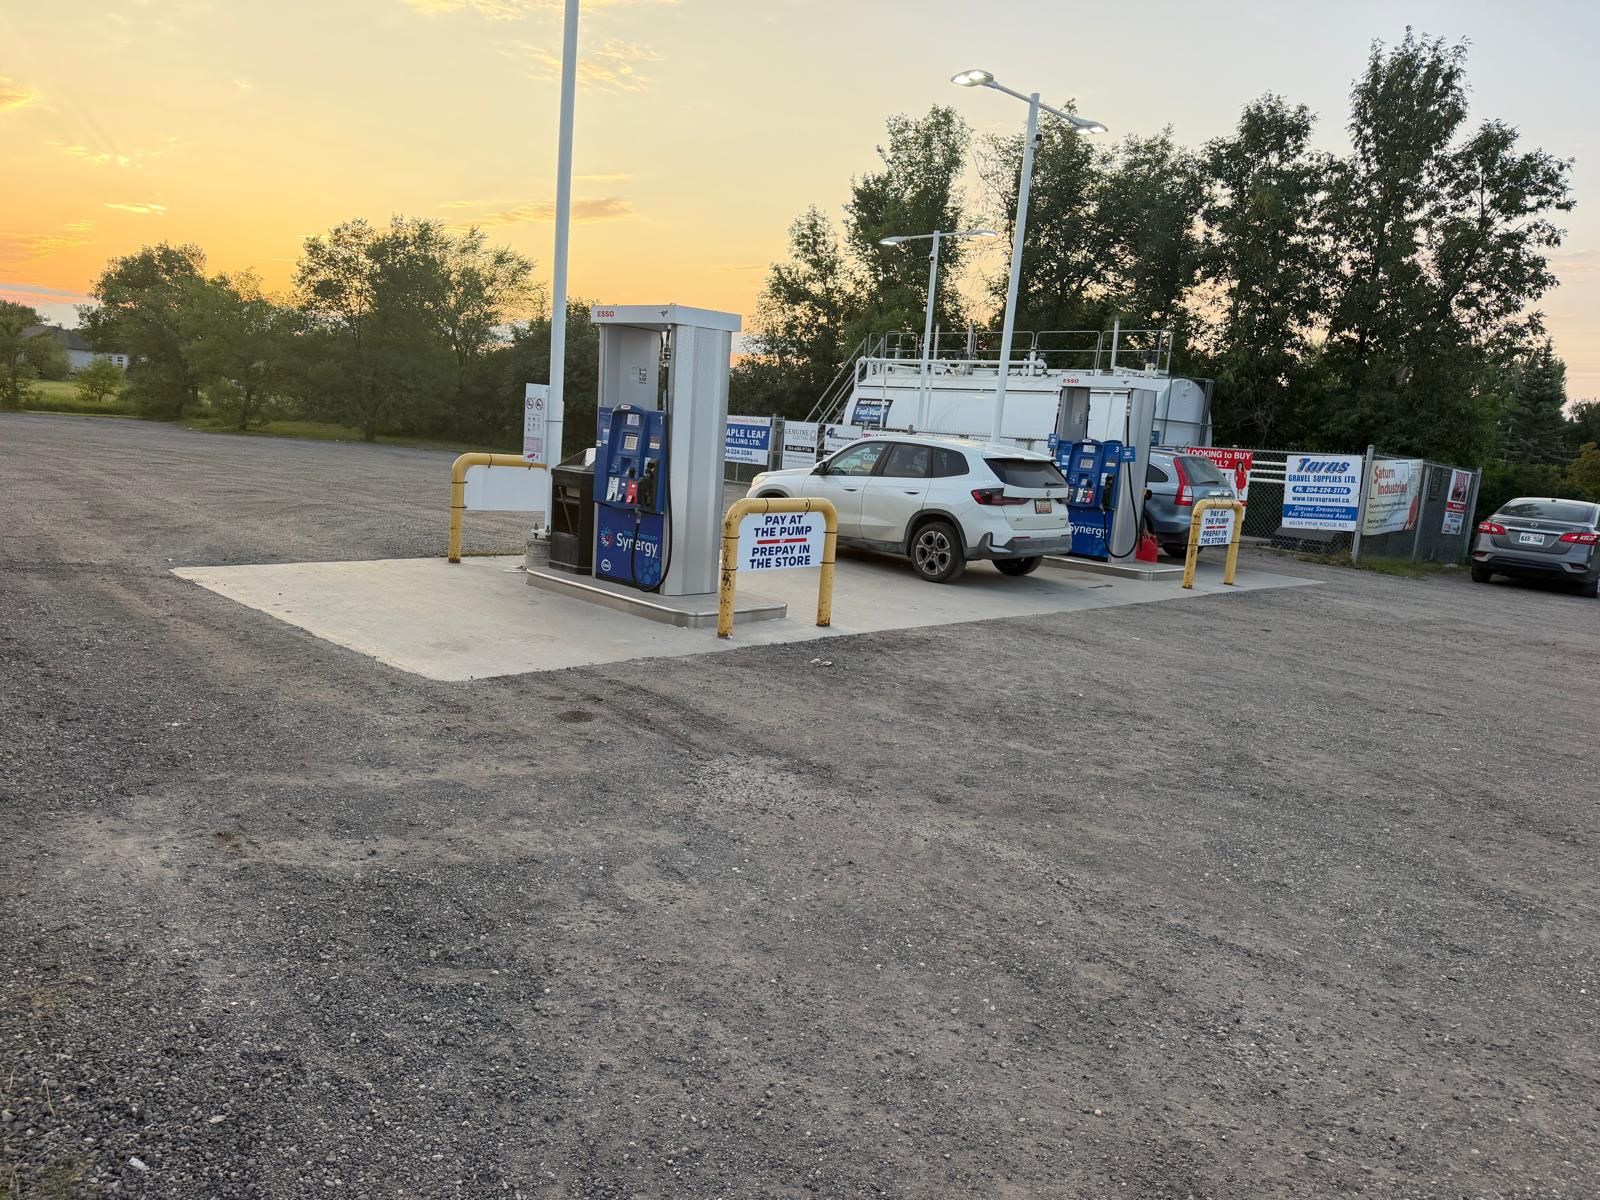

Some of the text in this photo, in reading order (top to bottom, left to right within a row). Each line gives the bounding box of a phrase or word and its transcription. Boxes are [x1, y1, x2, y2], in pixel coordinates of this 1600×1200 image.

[747, 430, 766, 439] LEAF
[1188, 449, 1252, 460] LOOKING to BUY
[1297, 457, 1350, 474] Taras
[1288, 474, 1310, 482] GRAVEL
[1313, 475, 1342, 483] SUPPLIES
[1374, 466, 1396, 484] Saturn
[1378, 481, 1408, 495] Industries
[765, 515, 804, 526] PAY AT
[754, 526, 812, 537] THE PUMP
[1068, 522, 1108, 538] Synergy
[616, 532, 658, 558] Synergy
[752, 544, 810, 557] PREPAY IN
[750, 556, 811, 569] THE STORE
